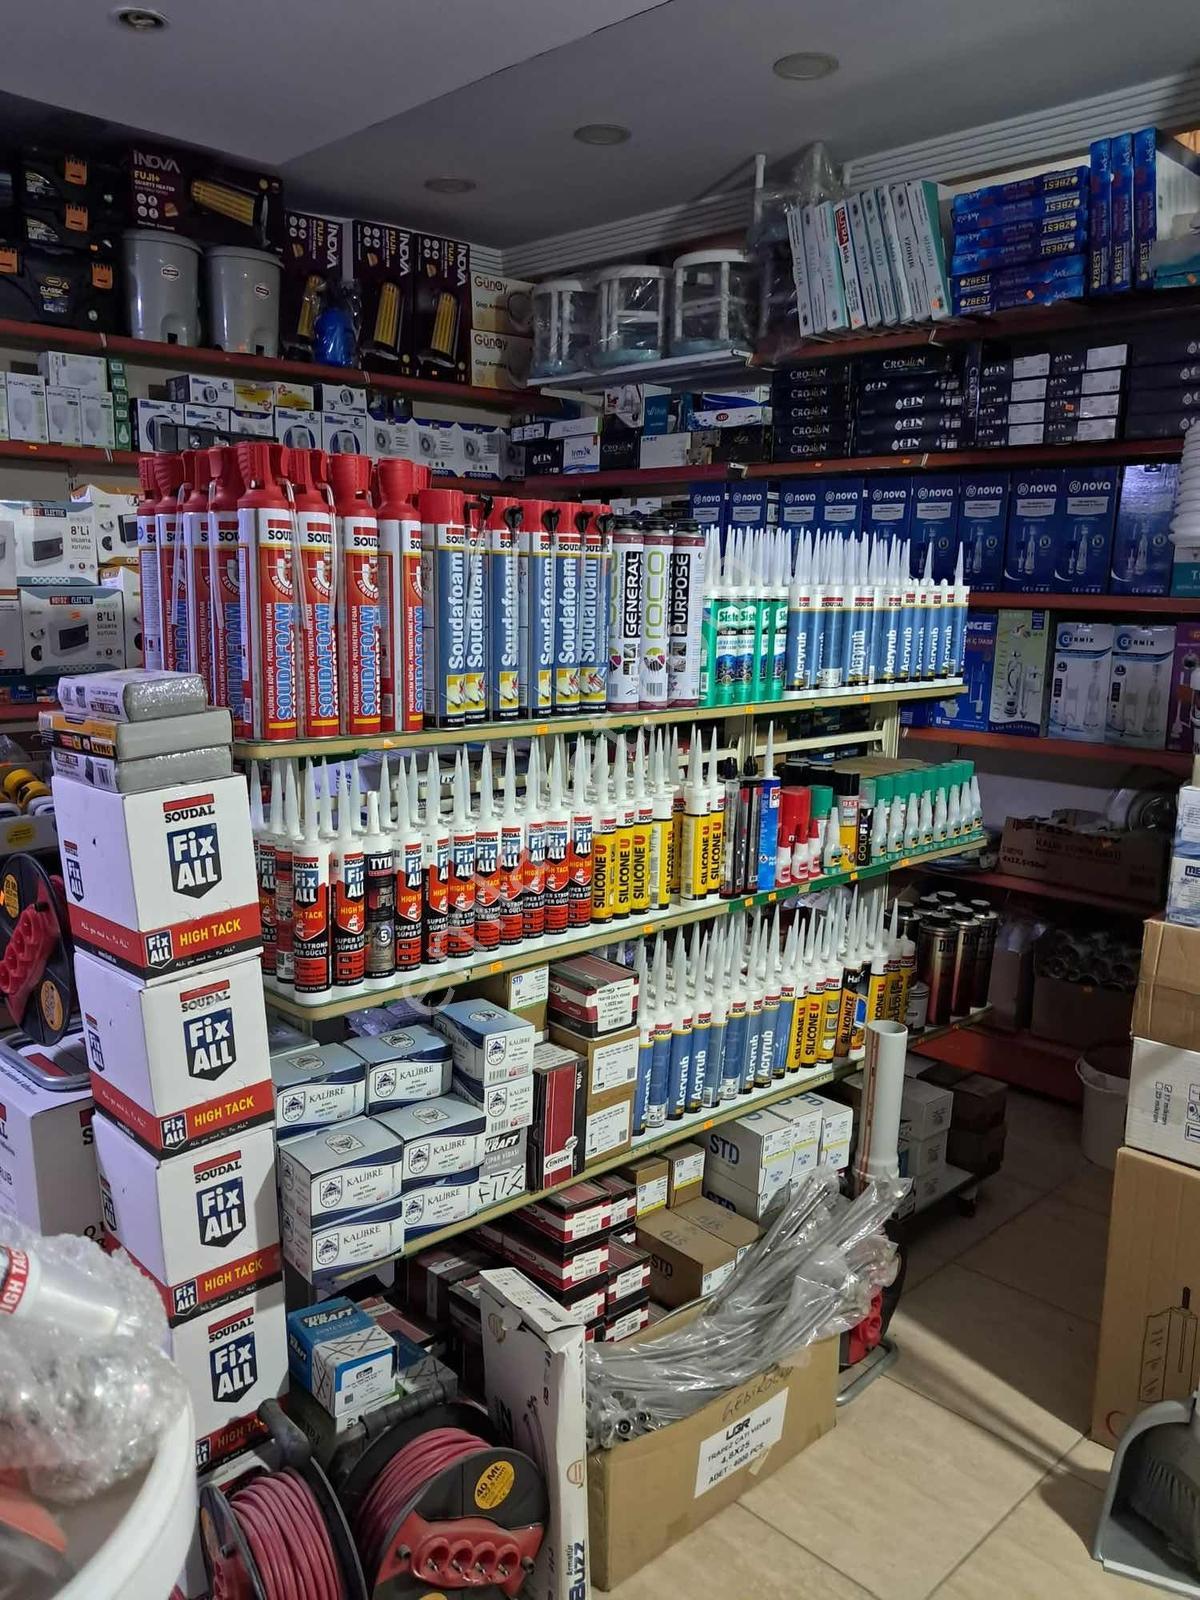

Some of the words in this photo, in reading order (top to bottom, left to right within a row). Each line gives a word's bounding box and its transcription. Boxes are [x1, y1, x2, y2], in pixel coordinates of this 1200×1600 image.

[741, 492, 762, 501] nova
[794, 493, 816, 502] nova
[835, 491, 858, 501] nova
[883, 490, 906, 499] nova
[929, 488, 954, 497] nova
[977, 486, 1003, 495] nova
[1029, 483, 1057, 493] nova
[1082, 480, 1111, 491] nova
[701, 493, 721, 503] nova
[627, 552, 640, 636] GENERAL
[645, 551, 665, 639] roco
[673, 555, 690, 635] PURPOSE
[448, 552, 464, 670] Soudafoam
[558, 557, 577, 664] Soudafoam
[314, 603, 333, 718] SOUDAFOAM
[794, 632, 807, 680] Acryrub
[883, 629, 897, 674] Acryrub
[900, 627, 913, 672] Acryrub
[928, 627, 939, 670] Acryrub
[274, 603, 293, 720] SOUDAFOAM
[359, 606, 376, 716] SOUDAFOAM
[165, 804, 216, 824] SOUDAL
[702, 826, 710, 835] U
[713, 822, 722, 831] U
[172, 831, 216, 862] Fix
[477, 844, 496, 859] Fix
[549, 833, 566, 847] Fix
[575, 842, 591, 854] ALL
[595, 844, 607, 854] U
[620, 838, 631, 848] U
[634, 835, 646, 845] U
[476, 857, 497, 872] ALL
[547, 846, 566, 860] ALL
[701, 839, 710, 885] SILICONE
[710, 833, 722, 880] SILICONE
[177, 857, 218, 890] ALL
[293, 871, 316, 888] Fix
[594, 855, 607, 908] SILICONE
[619, 851, 631, 904] SILICONE
[633, 846, 646, 899] SILICONE
[295, 886, 317, 903] ALL
[304, 911, 324, 920] TACK
[148, 933, 170, 948] Fix
[180, 926, 209, 946] HIGH
[212, 918, 242, 940] TACK
[380, 929, 387, 941] 5
[150, 945, 171, 961] ALL
[302, 941, 328, 950] STRONG
[181, 992, 231, 1013] SOUDAL
[810, 1003, 820, 1012] U
[188, 1017, 230, 1048] Fix
[805, 1012, 820, 1056] SILICONE
[193, 1040, 233, 1075] ALL
[746, 1034, 759, 1081] Acryrub
[757, 1030, 774, 1076] Acryrub
[676, 1055, 690, 1106] Acryrub
[691, 1050, 706, 1101] Acryrub
[194, 1108, 223, 1127] HIGH
[225, 1095, 255, 1115] TACK
[163, 1118, 184, 1134] Fix
[165, 1130, 186, 1147] ALL
[709, 1134, 740, 1166] STD
[195, 1160, 242, 1184] SOUDAL
[200, 1186, 241, 1217] Fix
[203, 1212, 243, 1242] ALL
[204, 1271, 231, 1292] HIGH
[233, 1256, 263, 1283] TACK
[649, 1254, 673, 1279] STD
[175, 1281, 196, 1301] Fix
[176, 1296, 197, 1315] ALL
[308, 1307, 353, 1328] KRAFT
[208, 1318, 254, 1343] SOUDAL
[213, 1341, 252, 1375] Fix
[216, 1368, 255, 1401] ALL
[217, 1427, 244, 1450] HIGH
